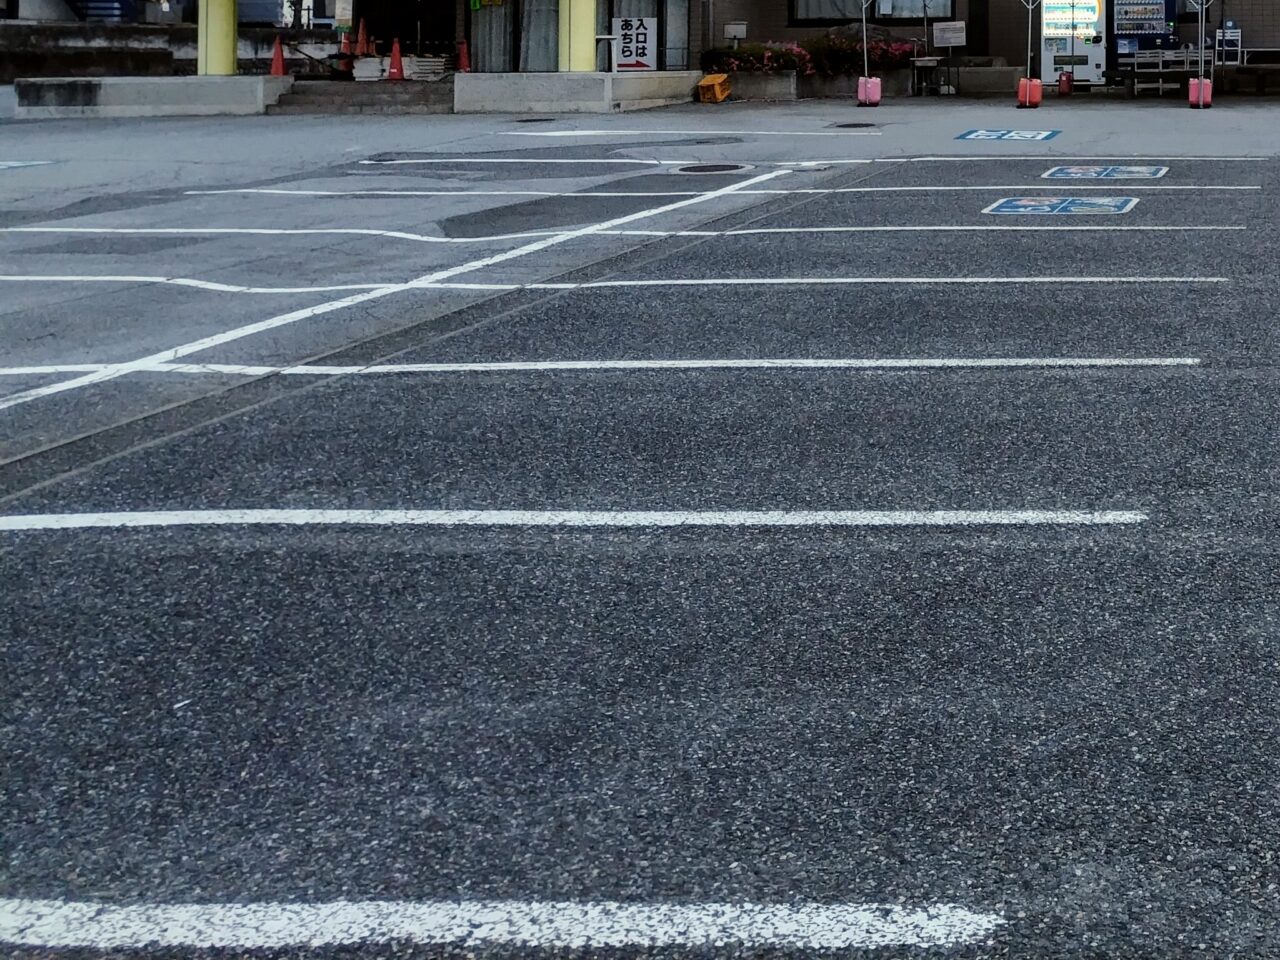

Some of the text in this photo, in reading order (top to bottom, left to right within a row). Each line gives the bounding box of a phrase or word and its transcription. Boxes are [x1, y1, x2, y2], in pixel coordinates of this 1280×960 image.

[620, 18, 633, 58] あちら
[635, 18, 648, 58] 入口は
